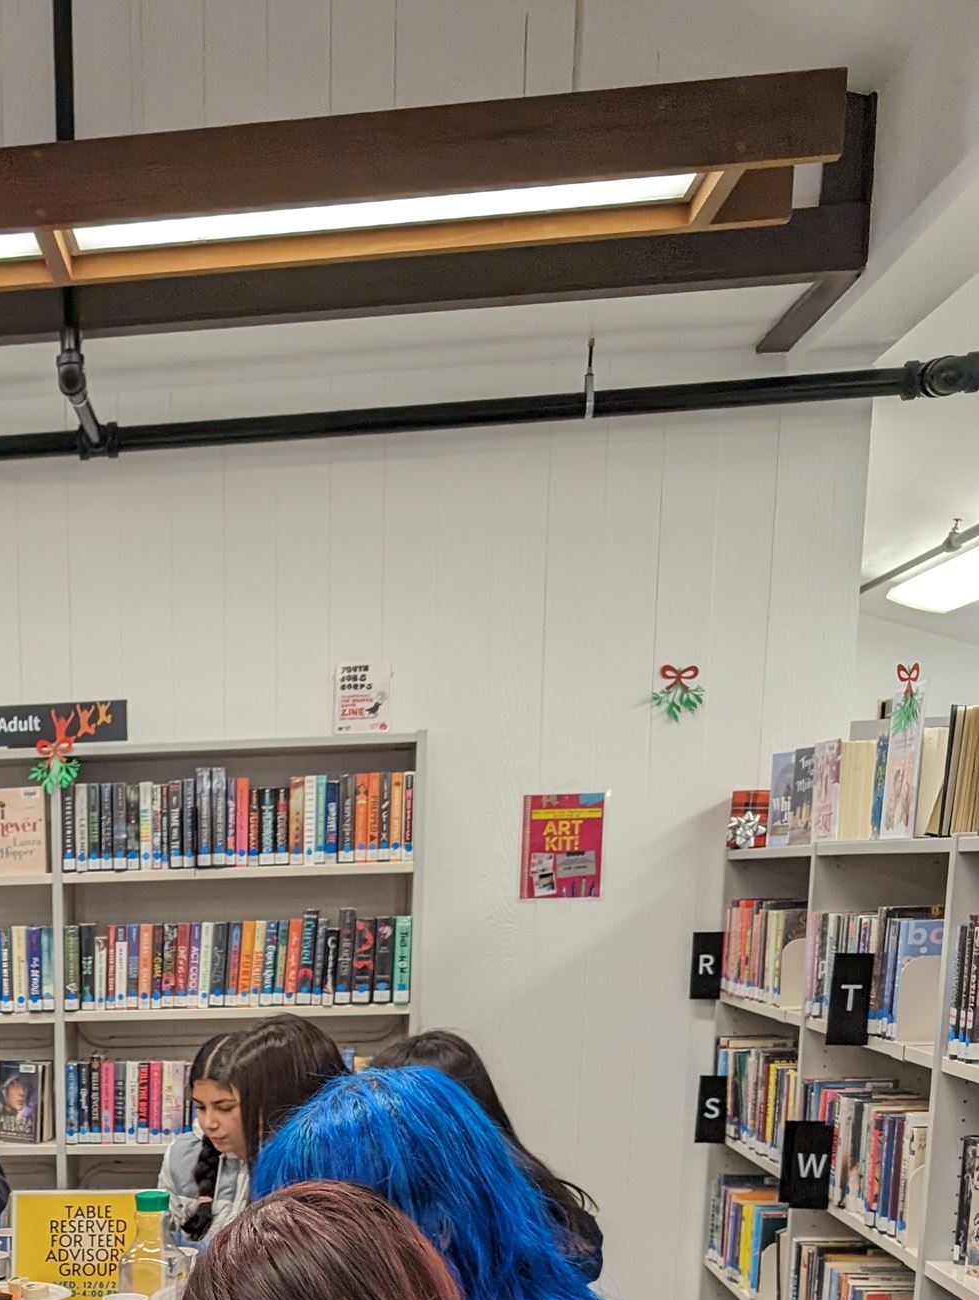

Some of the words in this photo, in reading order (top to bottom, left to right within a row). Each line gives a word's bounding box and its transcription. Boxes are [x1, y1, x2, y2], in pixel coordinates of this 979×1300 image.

[341, 708, 364, 716] ZINE
[64, 797, 73, 851] STEELSTRIKE
[542, 820, 583, 836] ART
[545, 835, 579, 851] KIT!
[190, 946, 199, 964] ACT
[699, 953, 714, 975] R
[841, 985, 863, 1012] T
[139, 1067, 148, 1084] KILL
[139, 1087, 148, 1100] THE
[704, 1098, 721, 1119] S
[797, 1153, 827, 1179] W
[64, 1205, 112, 1219] TABLE
[50, 1219, 127, 1233] RESERVED
[51, 1234, 83, 1248] FOR
[88, 1234, 125, 1247] TEEN
[45, 1248, 125, 1262] ADVISOR
[59, 1263, 117, 1276] GROUP
[83, 1281, 117, 1289] 12/6/2
